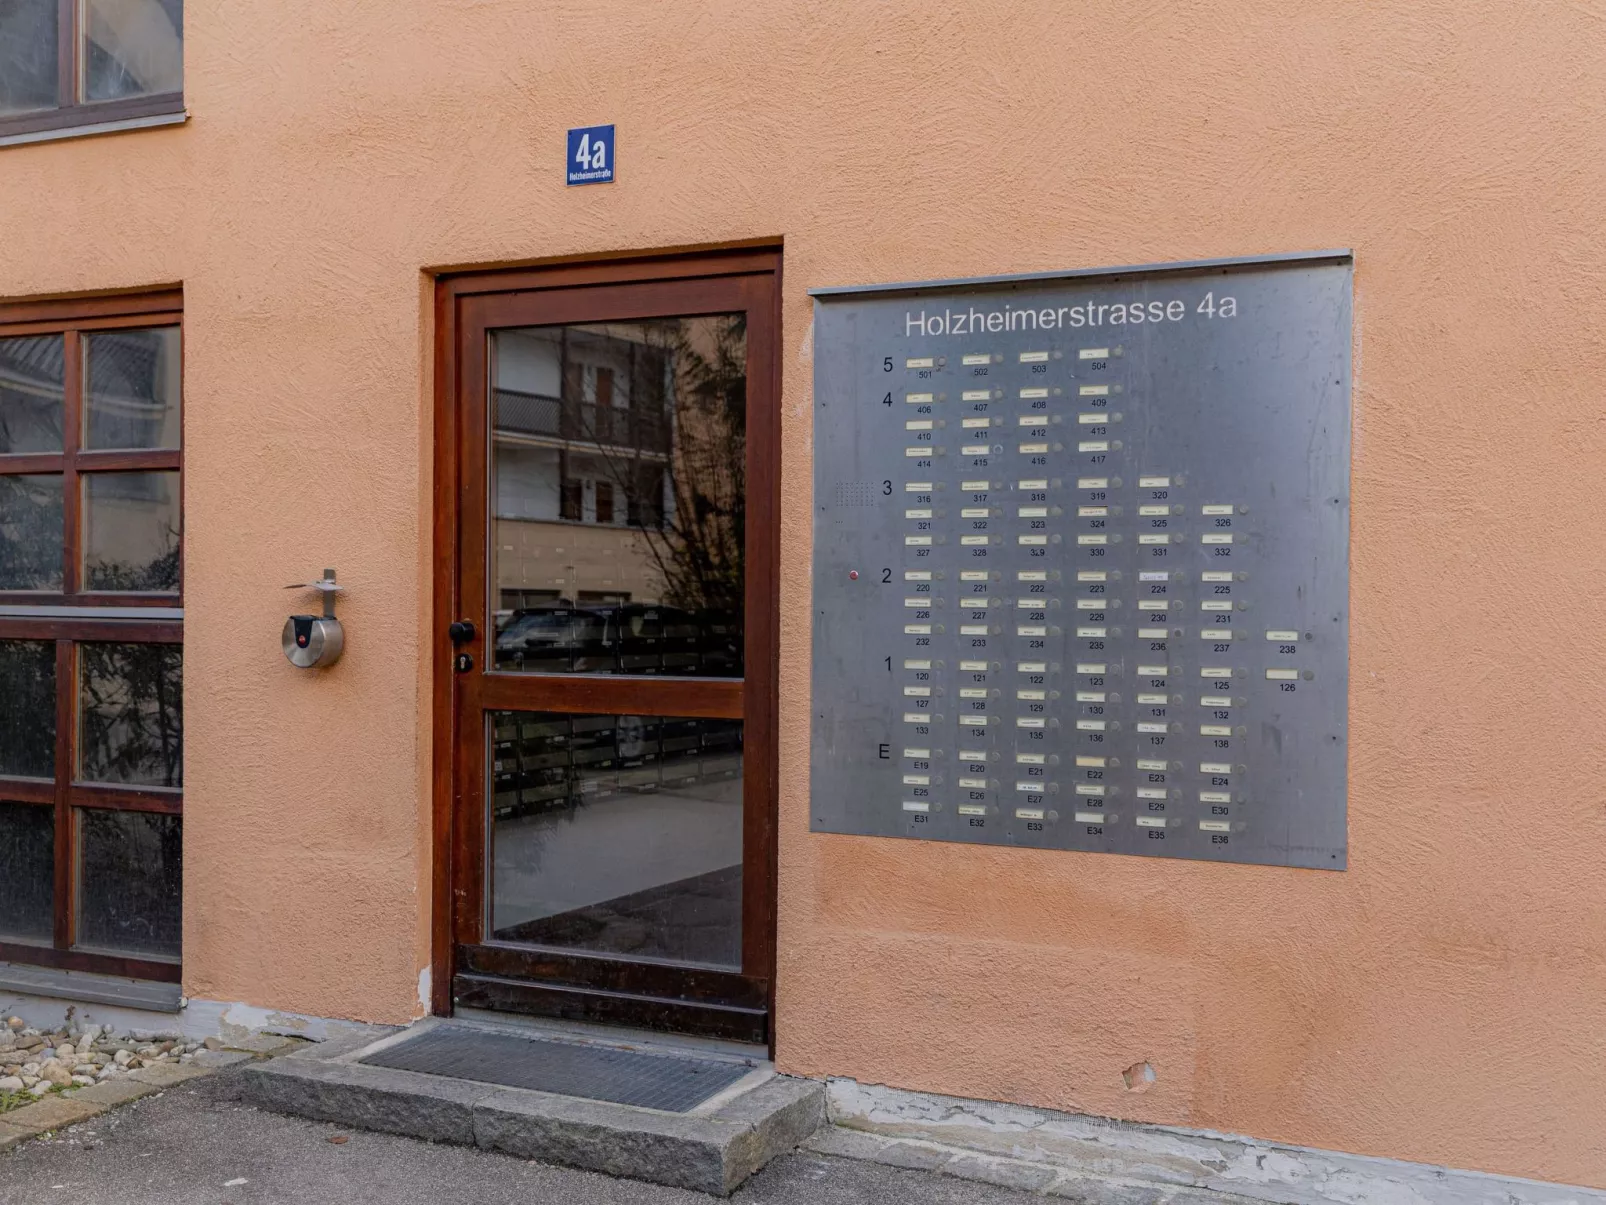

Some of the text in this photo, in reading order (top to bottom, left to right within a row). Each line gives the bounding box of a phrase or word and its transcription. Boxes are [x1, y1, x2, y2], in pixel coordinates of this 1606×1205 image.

[576, 134, 606, 170] 4a
[906, 292, 1236, 336] Holzheimerstrasse 4a
[883, 356, 893, 372] 5
[1091, 362, 1106, 370] 504
[974, 368, 988, 376] 502
[1032, 364, 1047, 374] 503
[919, 370, 932, 379] 501
[882, 392, 893, 407] 4
[1091, 398, 1107, 407] 409
[973, 403, 988, 412] 407
[1031, 401, 1046, 409] 408
[917, 406, 932, 414] 406
[974, 430, 987, 439] 411
[1031, 428, 1046, 437] 412
[1090, 427, 1106, 435] 413
[917, 432, 931, 440] 410
[973, 458, 988, 466] 415
[1031, 456, 1046, 465] 416
[1091, 455, 1106, 463] 417
[917, 460, 931, 468] 414
[883, 480, 892, 496] 3
[973, 494, 988, 502] 317
[1031, 493, 1046, 501] 318
[1090, 492, 1106, 500] 319
[1152, 491, 1168, 499] 320
[973, 521, 988, 529] 322
[1030, 520, 1045, 529] 323
[1090, 520, 1105, 528] 324
[1151, 519, 1167, 528] 325
[1215, 518, 1231, 527] 326
[972, 548, 987, 557] 328
[1030, 548, 1045, 557] 329
[1090, 548, 1105, 557] 330
[1152, 548, 1167, 556] 331
[1215, 548, 1231, 556] 332
[882, 568, 892, 584] 2
[916, 584, 930, 592] 220
[973, 584, 987, 592] 221
[1030, 584, 1045, 593] 222
[1089, 585, 1105, 593] 223
[1151, 585, 1166, 594] 224
[1214, 585, 1231, 594] 225
[916, 610, 930, 619] 226
[972, 612, 986, 620] 227
[1029, 612, 1045, 620] 228
[1089, 613, 1105, 621] 229
[1151, 614, 1167, 622] 230
[1215, 614, 1231, 623] 231
[916, 638, 930, 646] 232
[972, 639, 986, 647] 233
[1030, 640, 1044, 648] 234
[1089, 641, 1105, 650] 235
[1150, 642, 1167, 651] 236
[1214, 644, 1230, 652] 237
[1279, 645, 1296, 654] 238
[885, 656, 891, 671] 1
[916, 672, 929, 680] 120
[1029, 676, 1044, 684] 122
[1089, 677, 1104, 686] 123
[1151, 679, 1165, 688] 124
[1214, 681, 1230, 690] 125
[1280, 683, 1296, 692] 126
[916, 700, 929, 708] 127
[972, 702, 986, 710] 128
[1029, 704, 1044, 712] 129
[1089, 706, 1104, 715] 130
[1151, 708, 1166, 716] 131
[1213, 710, 1229, 719] 132
[916, 726, 929, 735] 133
[972, 729, 985, 737] 134
[1029, 731, 1044, 740] 135
[1089, 734, 1104, 742] 136
[1150, 736, 1165, 745] 137
[1214, 740, 1229, 748] 138
[879, 743, 890, 759] E
[914, 761, 929, 770] E19
[969, 764, 985, 773] E20
[1028, 767, 1043, 776] E21
[1087, 770, 1103, 779] E22
[1148, 774, 1165, 783] E23
[1212, 777, 1229, 786] E24
[913, 788, 929, 796] E25
[969, 791, 985, 800] E26
[1027, 795, 1043, 804] E27
[1087, 798, 1103, 807] E28
[1148, 802, 1165, 811] E29
[1211, 806, 1229, 816] E30
[914, 814, 928, 823] E31
[969, 818, 985, 827] E32
[1027, 822, 1043, 831] E33
[1087, 826, 1103, 835] E34
[1148, 830, 1165, 840] E35
[1212, 835, 1229, 844] E36
